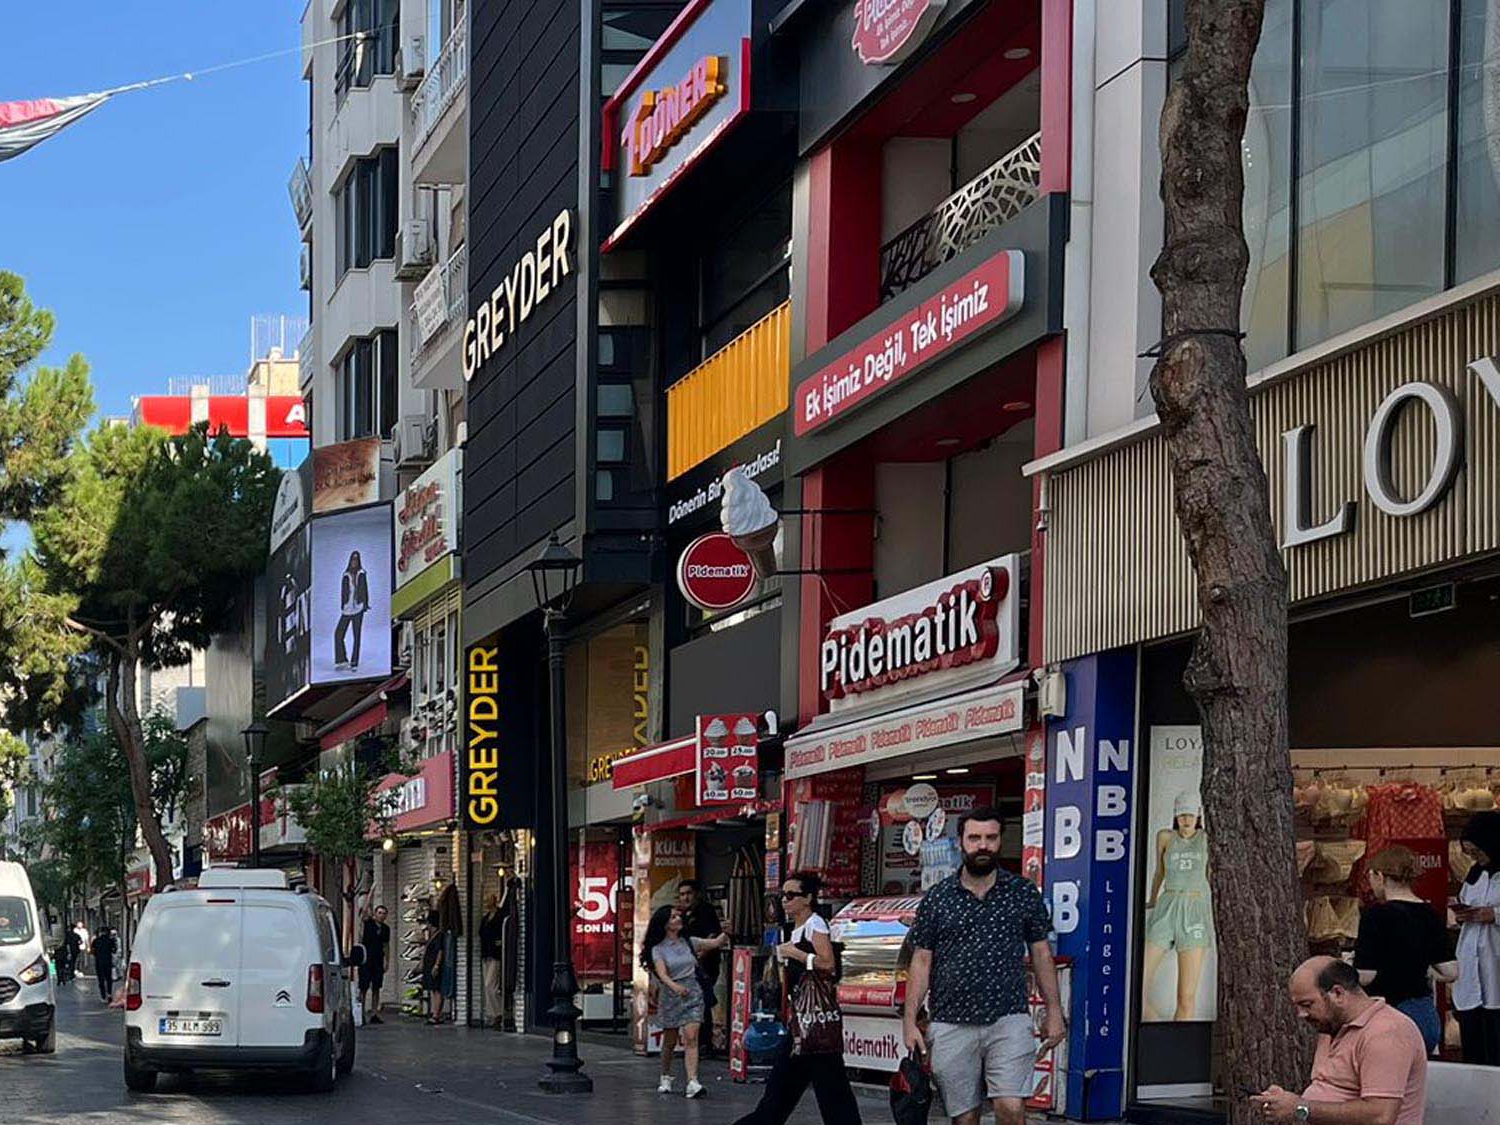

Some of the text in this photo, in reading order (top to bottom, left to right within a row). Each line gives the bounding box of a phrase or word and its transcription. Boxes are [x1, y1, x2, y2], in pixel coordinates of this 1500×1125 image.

[462, 208, 570, 382] GREYDER
[804, 280, 989, 422] Ek İşimiz Değil, Tek İşimiz
[668, 488, 707, 525] Dönerin
[707, 477, 722, 503] Bir
[688, 564, 748, 579] Pidematik
[821, 588, 978, 692] Pidematik
[468, 647, 499, 825] GREYDER
[790, 698, 1016, 768] Pidematik Pidematik Pidematik Pidematik Pidematik
[1053, 726, 1086, 934] NBB
[1095, 739, 1129, 861] NBB
[576, 923, 600, 933] SON
[167, 1022, 178, 1031] 35
[845, 1030, 899, 1060] idematik
